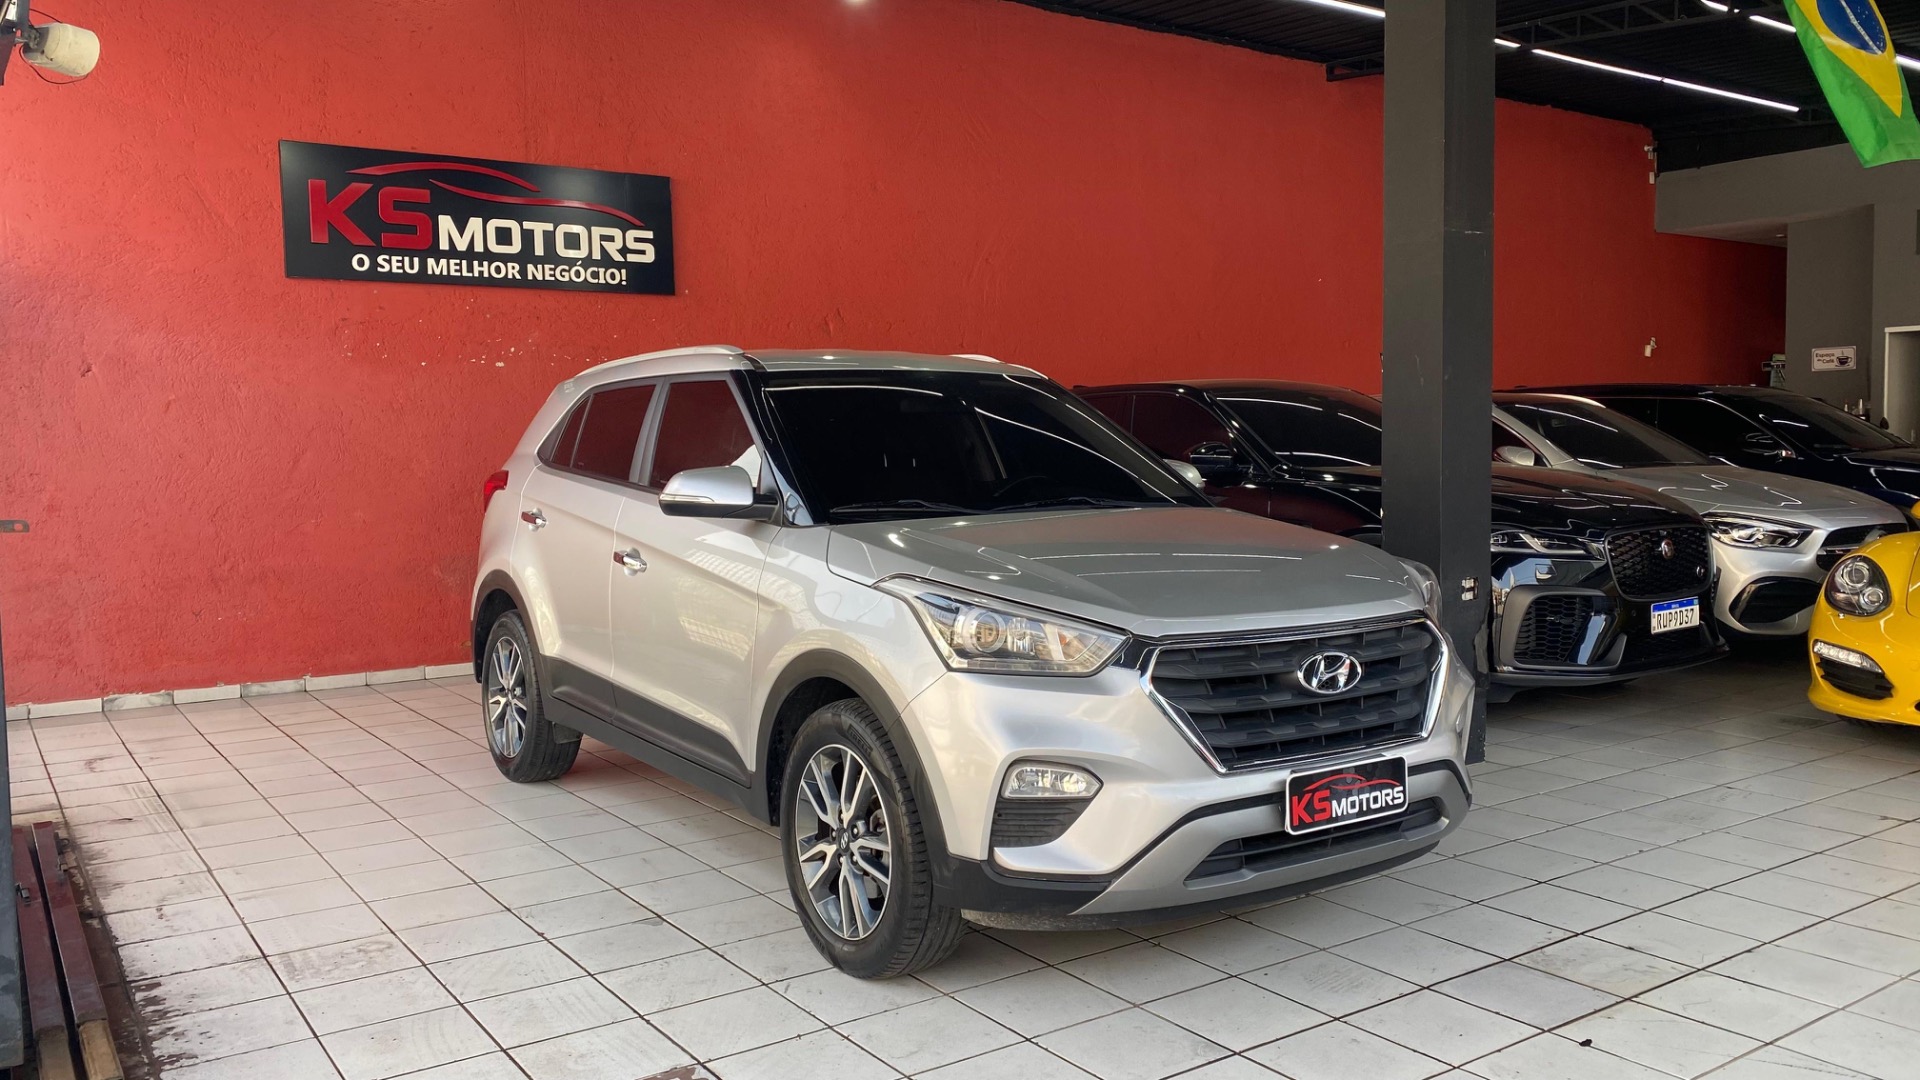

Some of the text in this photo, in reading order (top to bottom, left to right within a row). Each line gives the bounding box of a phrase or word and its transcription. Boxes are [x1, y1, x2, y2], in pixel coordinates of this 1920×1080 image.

[438, 214, 655, 263] MOTORS
[351, 253, 627, 286] O SEU MELHOR NEGÓCIO!
[1657, 608, 1695, 630] RUP9D37
[1331, 786, 1404, 818] MOTORS
